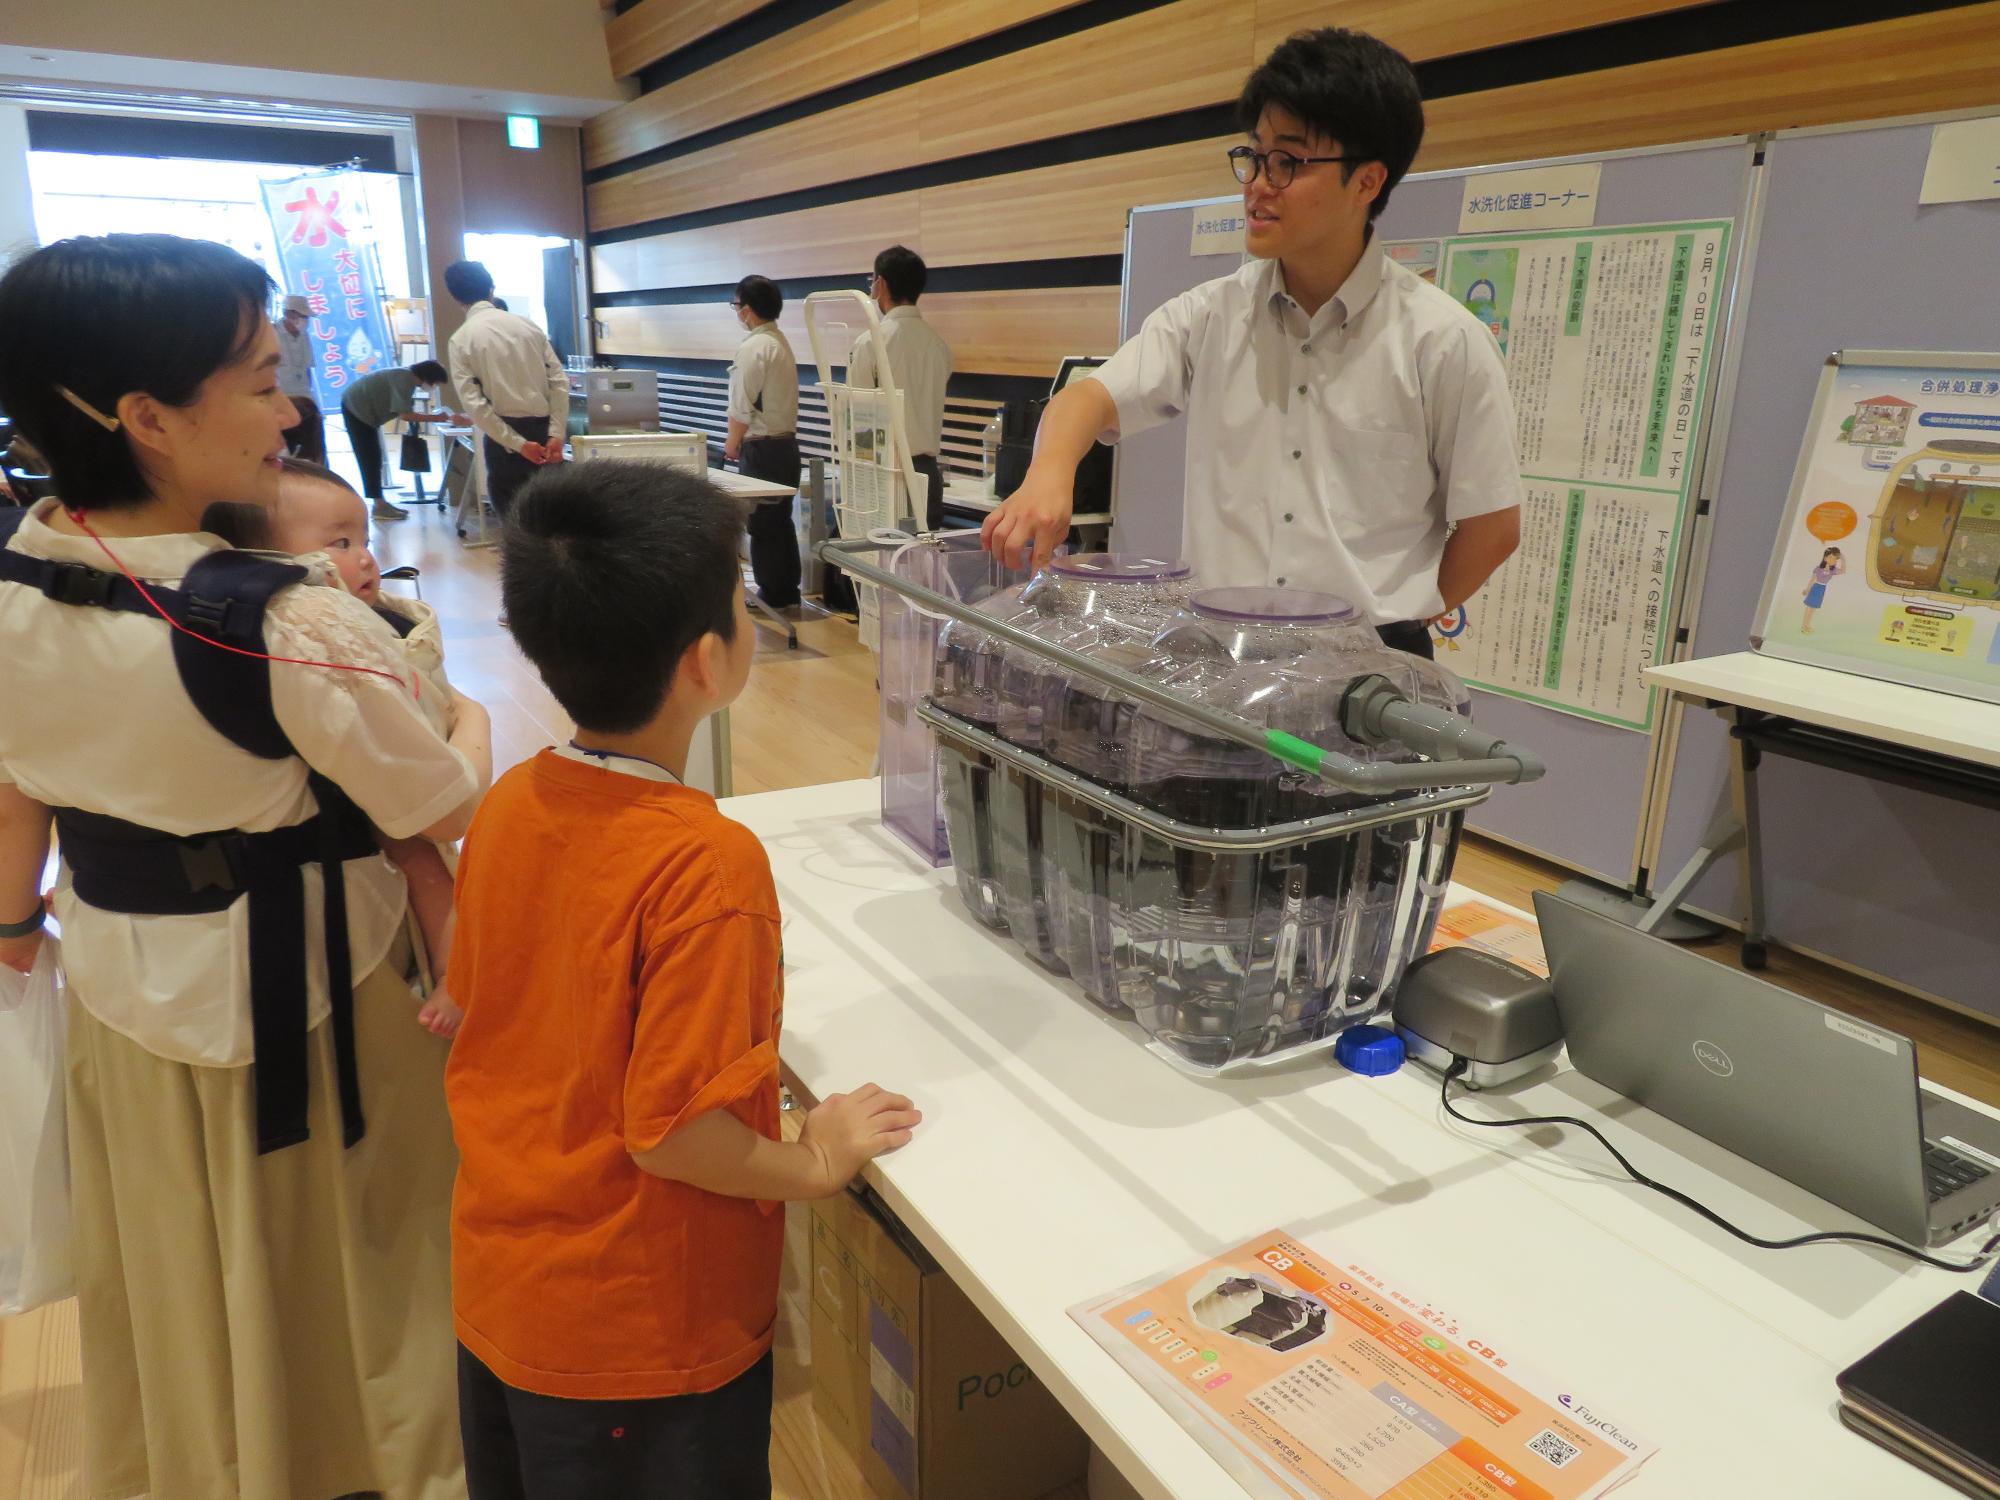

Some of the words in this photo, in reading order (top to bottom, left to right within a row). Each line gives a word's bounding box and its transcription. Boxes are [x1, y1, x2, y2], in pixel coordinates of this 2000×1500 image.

[285, 186, 349, 248] 水
[1468, 188, 1590, 214] 水洗化促進コーナー
[334, 248, 367, 322] 大切に
[303, 271, 348, 389] しましょう
[1263, 1250, 1294, 1272] CB
[1574, 1406, 1639, 1451] FujiClean
